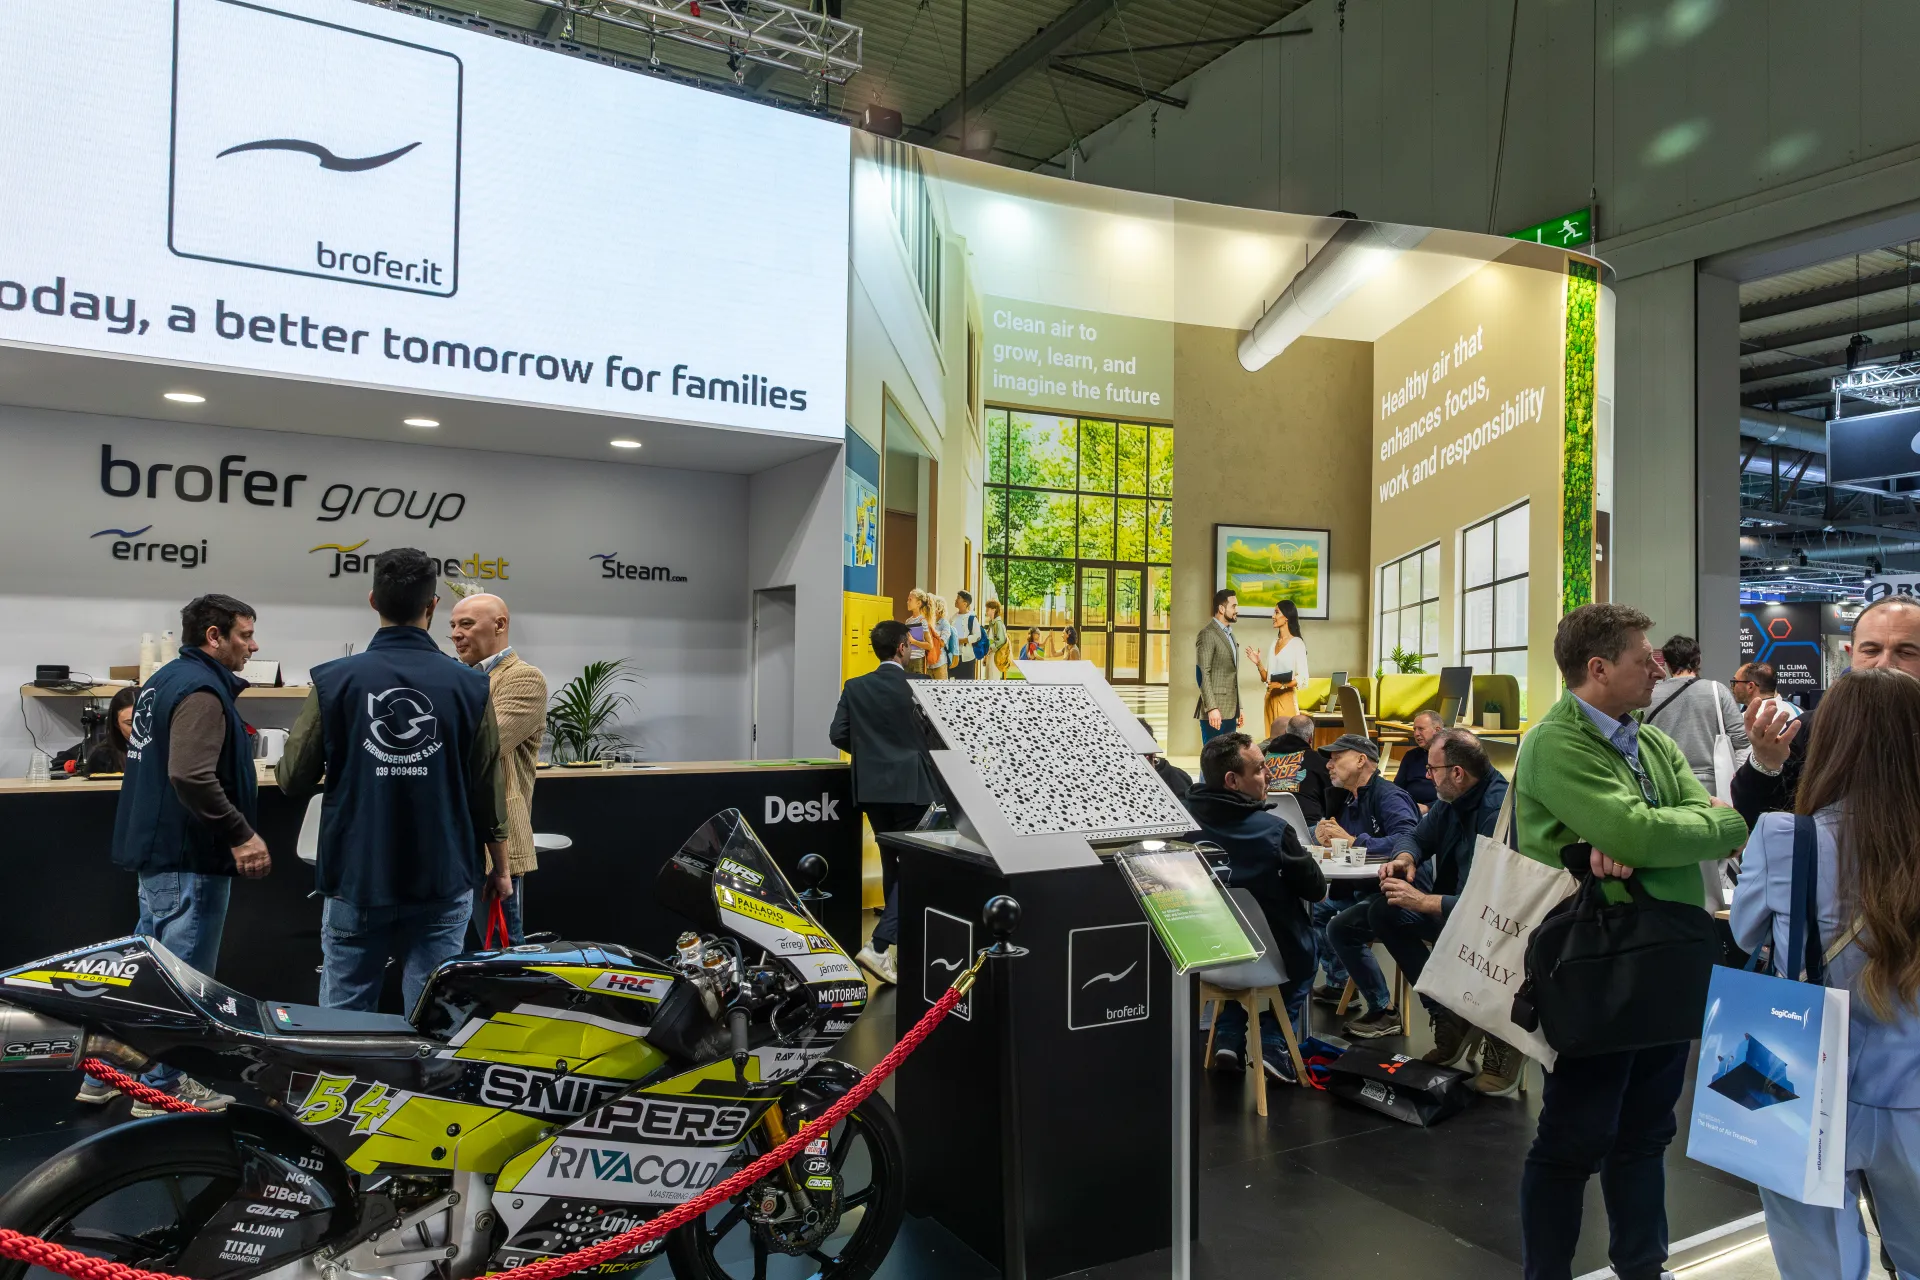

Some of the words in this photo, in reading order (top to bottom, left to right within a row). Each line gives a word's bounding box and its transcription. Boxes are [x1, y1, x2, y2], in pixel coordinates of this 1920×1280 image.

[316, 241, 443, 286] brofer.it
[993, 310, 1045, 334] Clean
[1051, 320, 1074, 338] air
[1079, 323, 1097, 341] to
[0, 277, 149, 336] oday,
[167, 304, 196, 333] a
[216, 299, 369, 355] better
[383, 327, 594, 384] tomorrow
[605, 355, 661, 393] for
[672, 364, 808, 412] families
[993, 343, 1042, 367] grow,
[1048, 346, 1098, 374] learn,
[1103, 357, 1136, 374] and
[1381, 368, 1429, 421] Healthy
[1432, 350, 1450, 384] air
[1454, 324, 1483, 368] that
[993, 369, 1066, 396] imagine
[1071, 380, 1100, 400] the
[1105, 383, 1160, 406] future
[1380, 405, 1441, 461] enhances
[1445, 376, 1490, 421] focus,
[1379, 464, 1410, 504] work
[1412, 445, 1437, 485] and
[1440, 386, 1546, 470] responsibility
[100, 443, 308, 508] brofer
[316, 484, 466, 529] group
[112, 539, 208, 569] erregi
[1280, 549, 1294, 557] NET
[1277, 564, 1296, 572] ZERO
[362, 738, 423, 764] THERMOSERVICE
[375, 766, 388, 776] 039
[390, 766, 428, 776] 9094953
[764, 792, 840, 824] Desk
[720, 860, 762, 884] WRS
[737, 897, 784, 920] PALLADIO
[1480, 905, 1528, 939] ITALY
[780, 938, 805, 950] erregi
[1458, 944, 1518, 986] EATALY
[75, 974, 111, 983] SPORT
[606, 974, 655, 994] HRC
[818, 986, 867, 1003] MOTORPARTS
[1106, 1004, 1145, 1020] brofer.it
[1771, 1007, 1802, 1021] SagiCofim
[294, 1070, 391, 1136] 54
[480, 1064, 751, 1141] SNIPERS
[285, 1172, 315, 1187] NGK
[546, 1146, 719, 1189] RIVACOLD
[276, 1188, 313, 1206] Beta
[648, 1189, 690, 1200] MASTERING
[246, 1203, 300, 1220] GALFER
[219, 1251, 261, 1265] RIEDMEIER
[223, 1239, 266, 1257] TITAN
